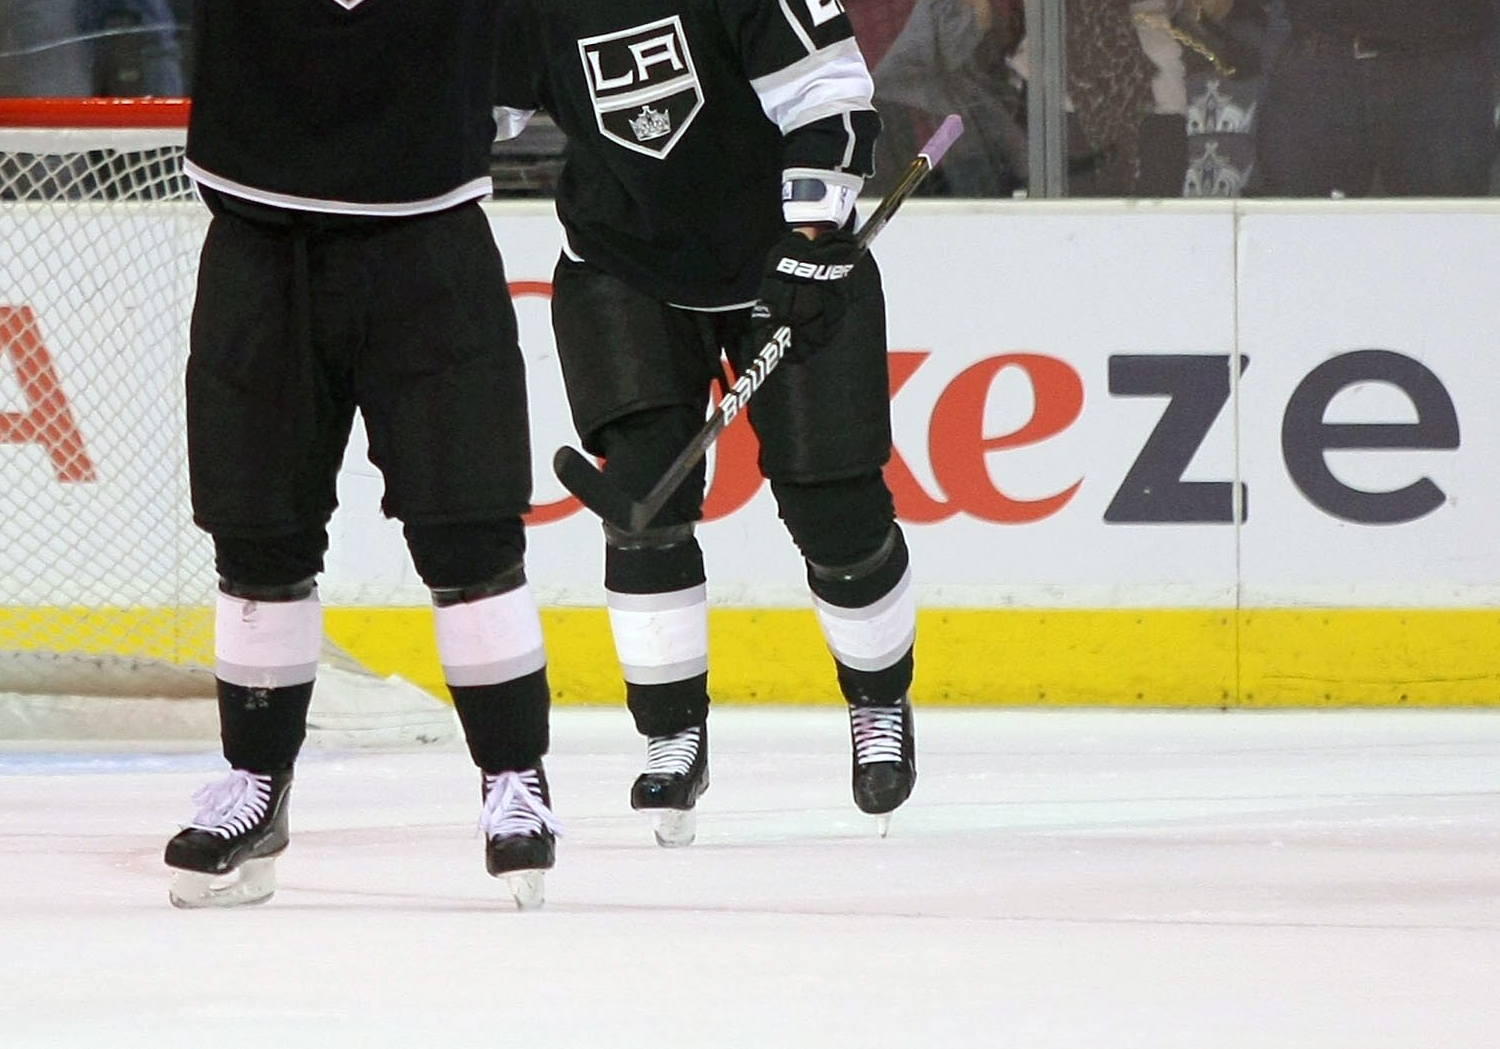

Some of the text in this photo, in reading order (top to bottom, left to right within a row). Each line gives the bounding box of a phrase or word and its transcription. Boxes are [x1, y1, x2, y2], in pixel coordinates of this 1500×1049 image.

[587, 32, 685, 91] LA
[776, 257, 854, 281] BAUER
[719, 325, 792, 426] BAUER
[1102, 349, 1461, 526] ze
